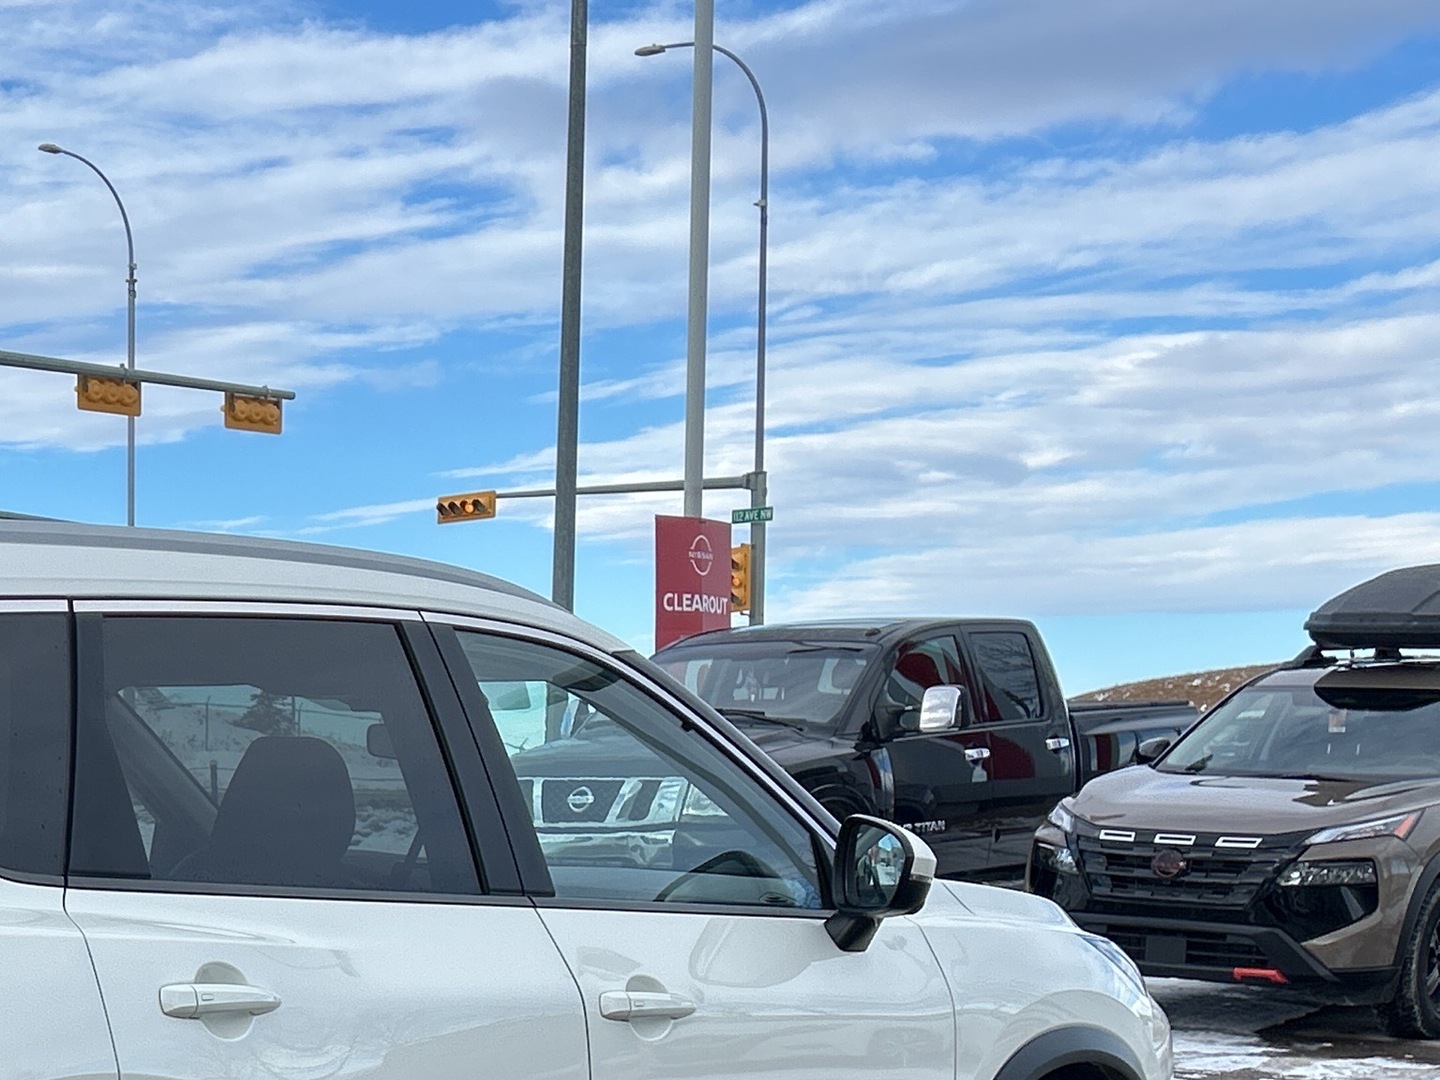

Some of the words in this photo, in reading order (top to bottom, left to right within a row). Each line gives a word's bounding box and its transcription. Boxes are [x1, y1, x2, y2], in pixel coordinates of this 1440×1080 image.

[744, 510, 759, 521] AVE
[760, 508, 772, 520] NW
[663, 592, 728, 615] CLEAROUT
[914, 820, 946, 832] TITAN
